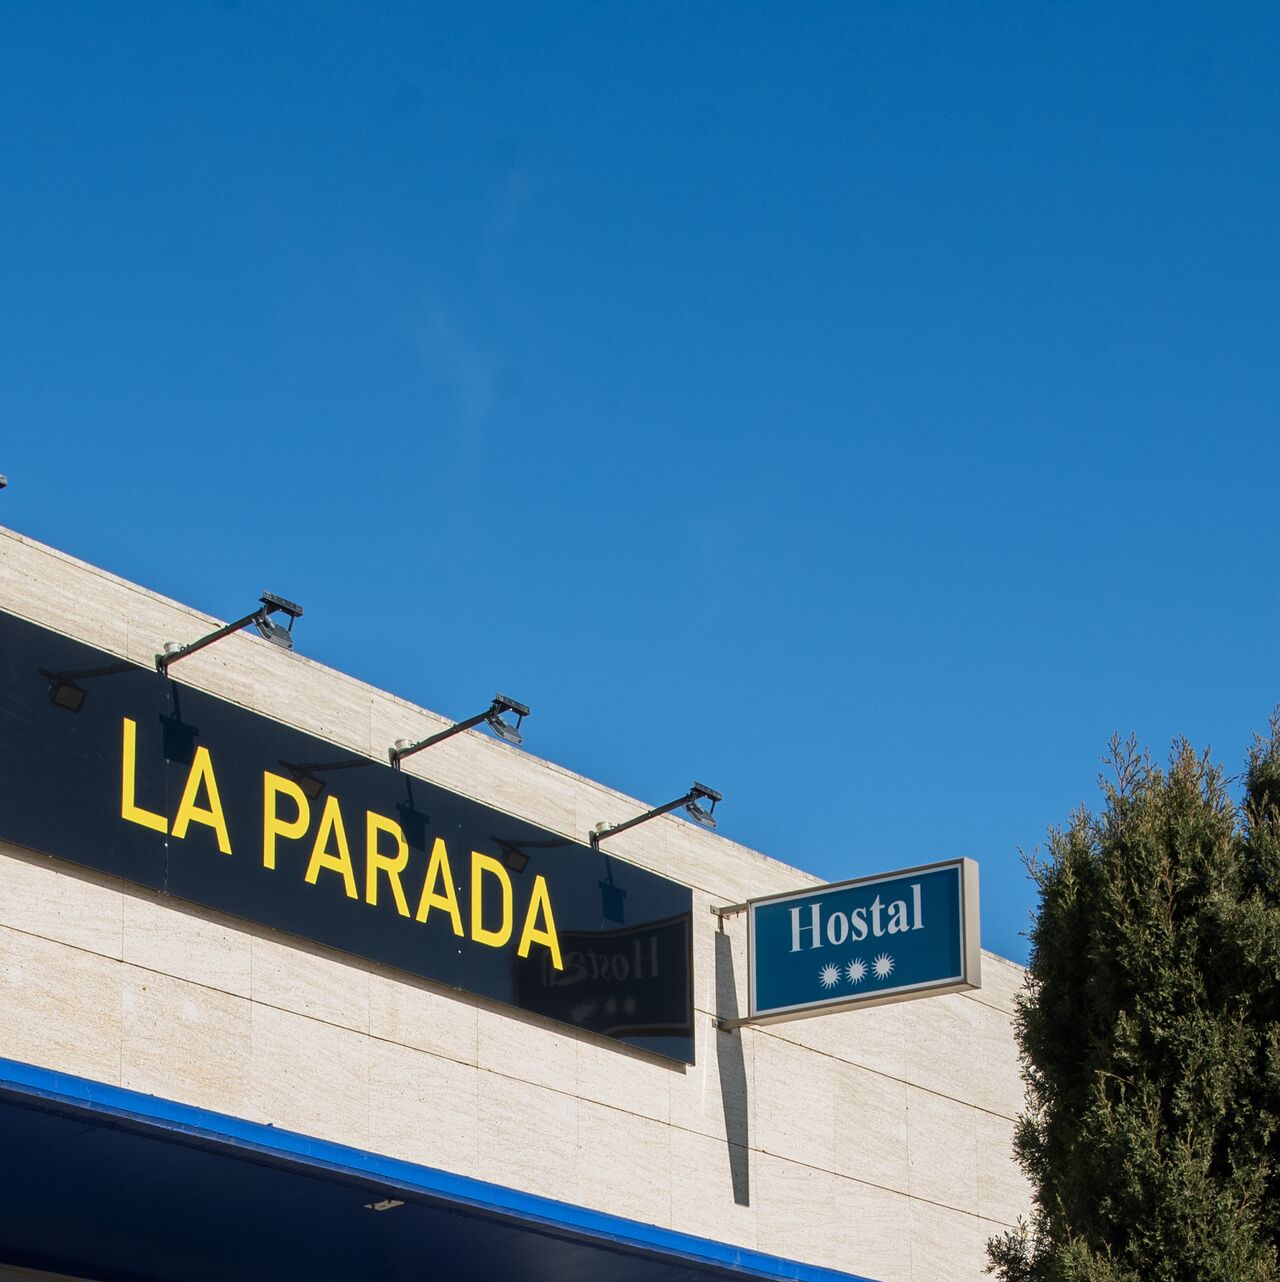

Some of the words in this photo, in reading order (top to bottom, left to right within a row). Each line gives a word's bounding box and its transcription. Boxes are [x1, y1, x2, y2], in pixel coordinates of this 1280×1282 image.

[121, 717, 233, 856] LA
[263, 770, 565, 971] PARADA
[789, 882, 926, 953] Hostal
